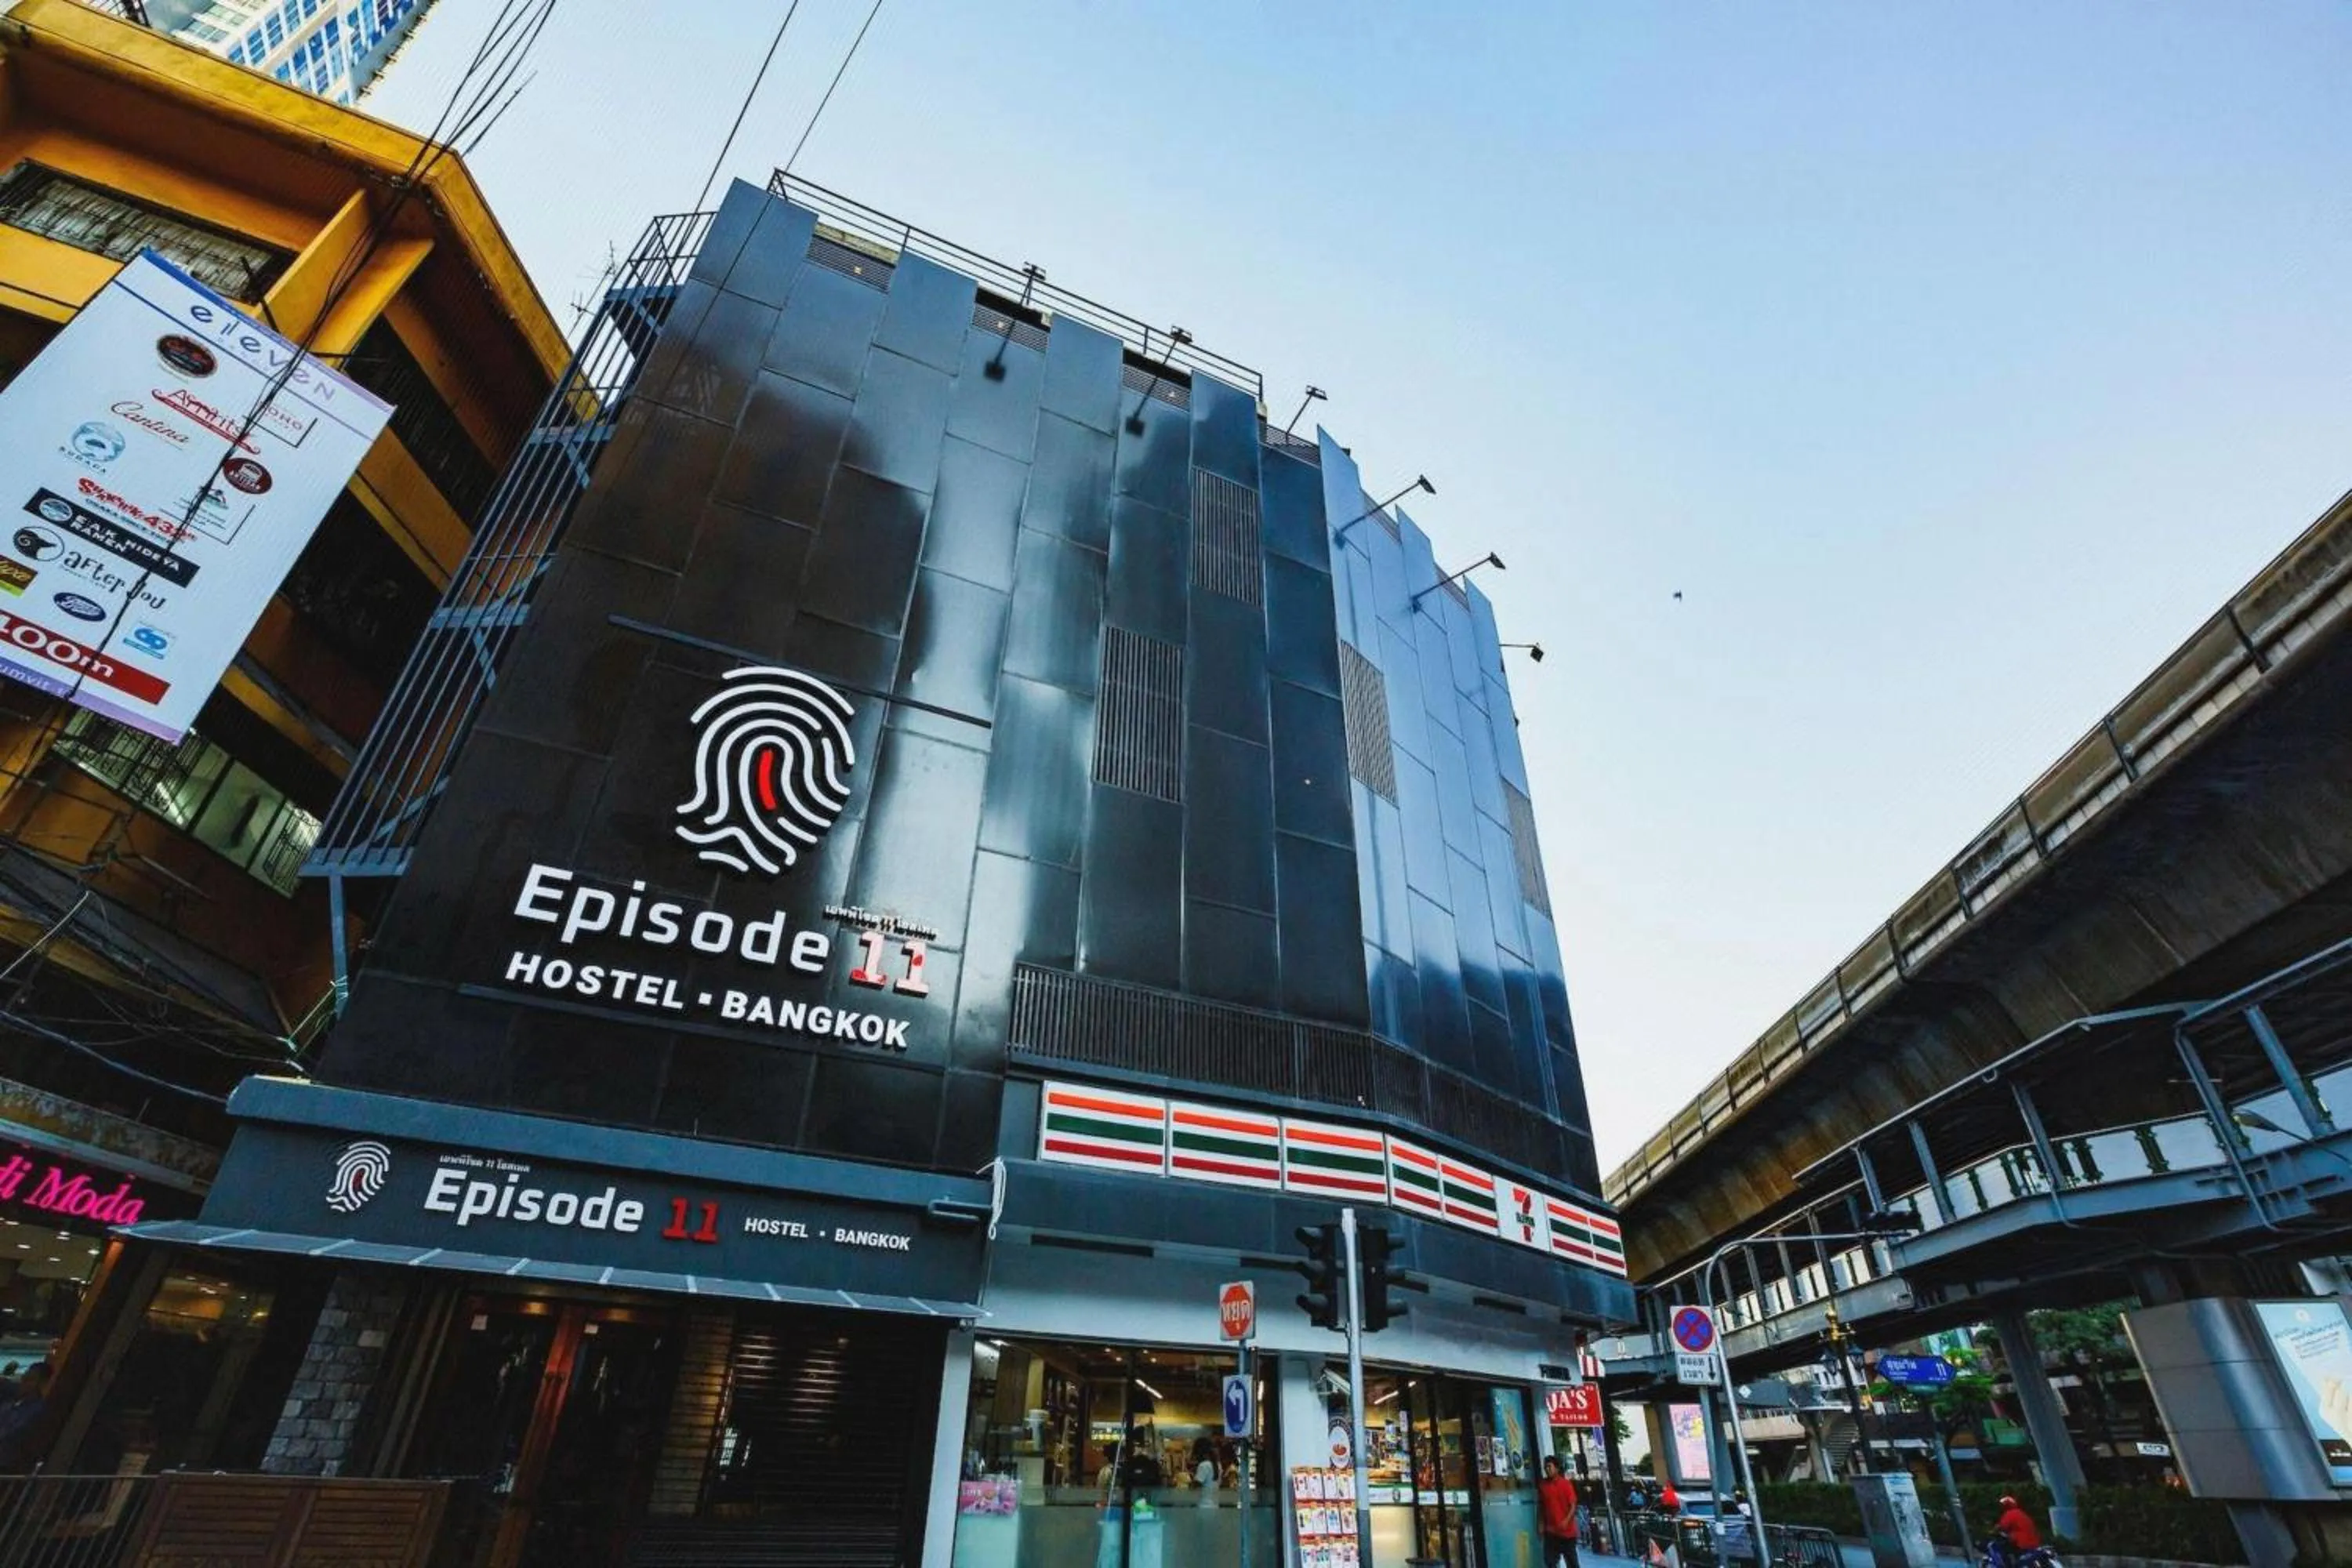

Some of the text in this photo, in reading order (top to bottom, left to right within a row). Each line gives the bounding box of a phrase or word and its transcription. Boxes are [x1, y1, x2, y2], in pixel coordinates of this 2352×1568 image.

[111, 401, 190, 444] Cantina
[71, 521, 128, 554] RAMEN
[514, 863, 930, 996] Episode 11
[505, 951, 911, 1048] HOSTEL BANGKOK
[23, 1167, 145, 1225] Moda
[423, 1167, 911, 1251] Episode 11 HOSTEL BANGKOK
